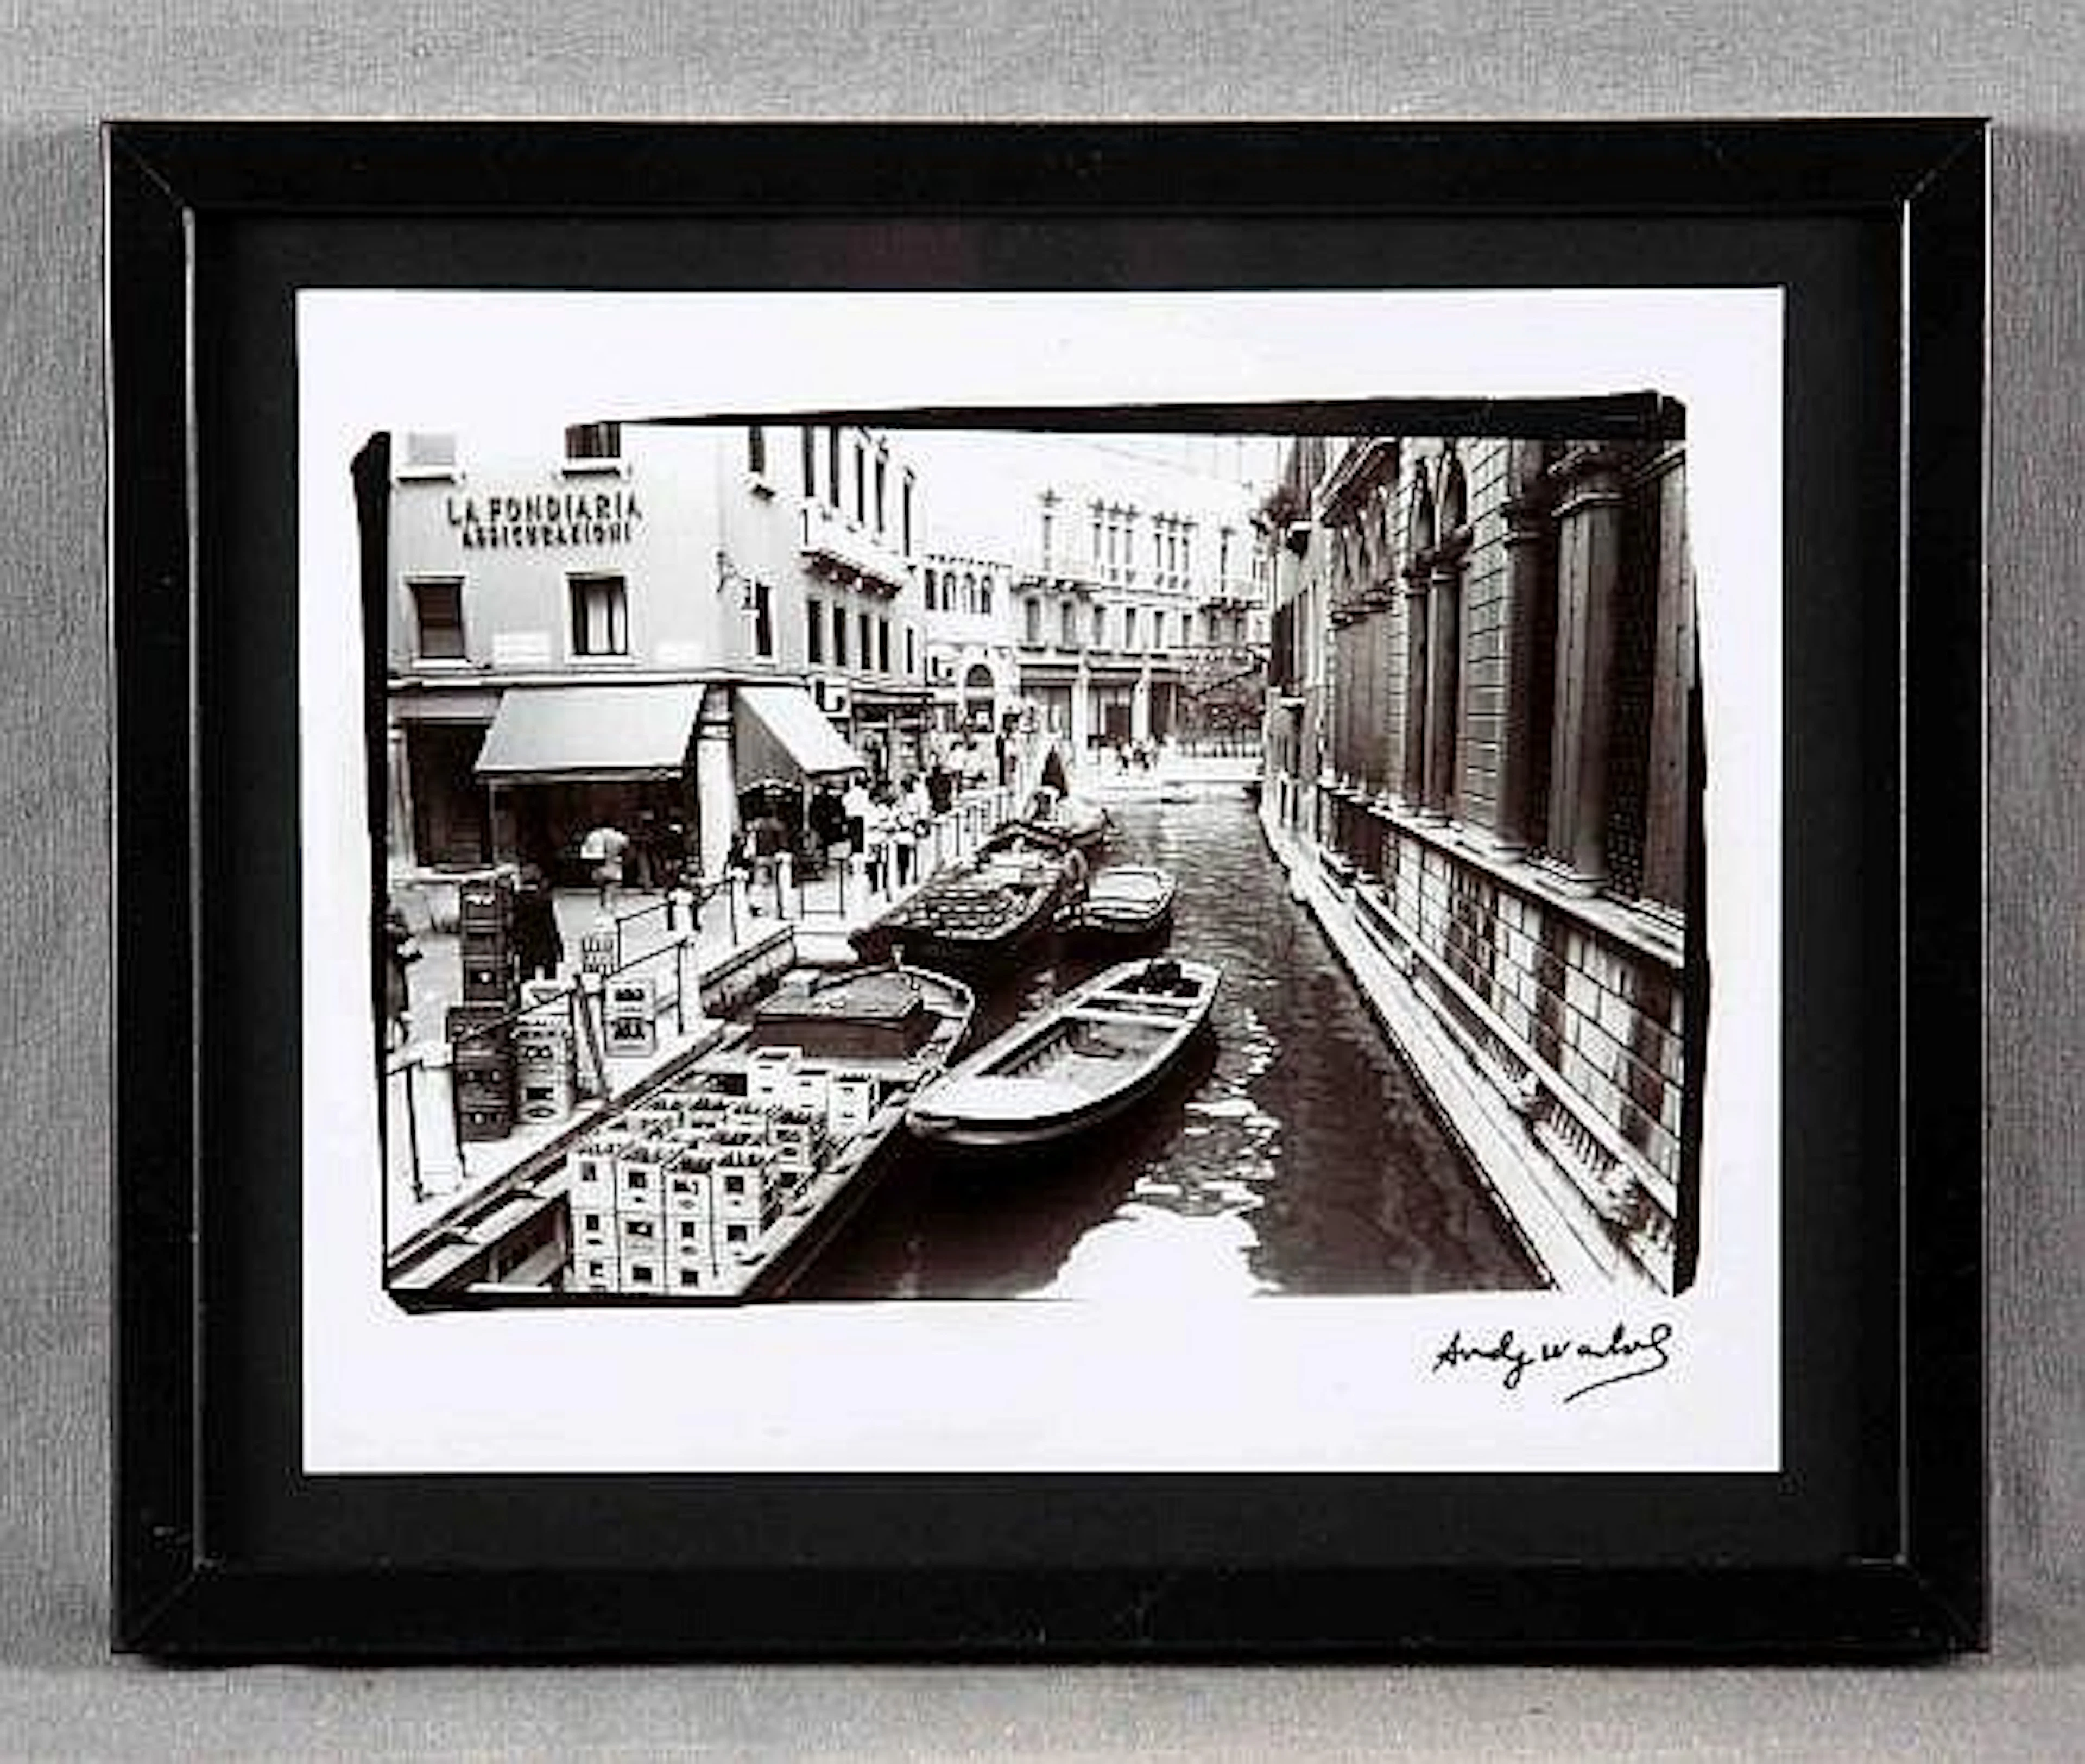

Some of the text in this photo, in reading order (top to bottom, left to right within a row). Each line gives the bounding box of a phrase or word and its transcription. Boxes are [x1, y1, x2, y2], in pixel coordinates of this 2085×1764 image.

[447, 490, 642, 526] LA FONDIARIA
[1432, 1330, 1534, 1389] Andy
